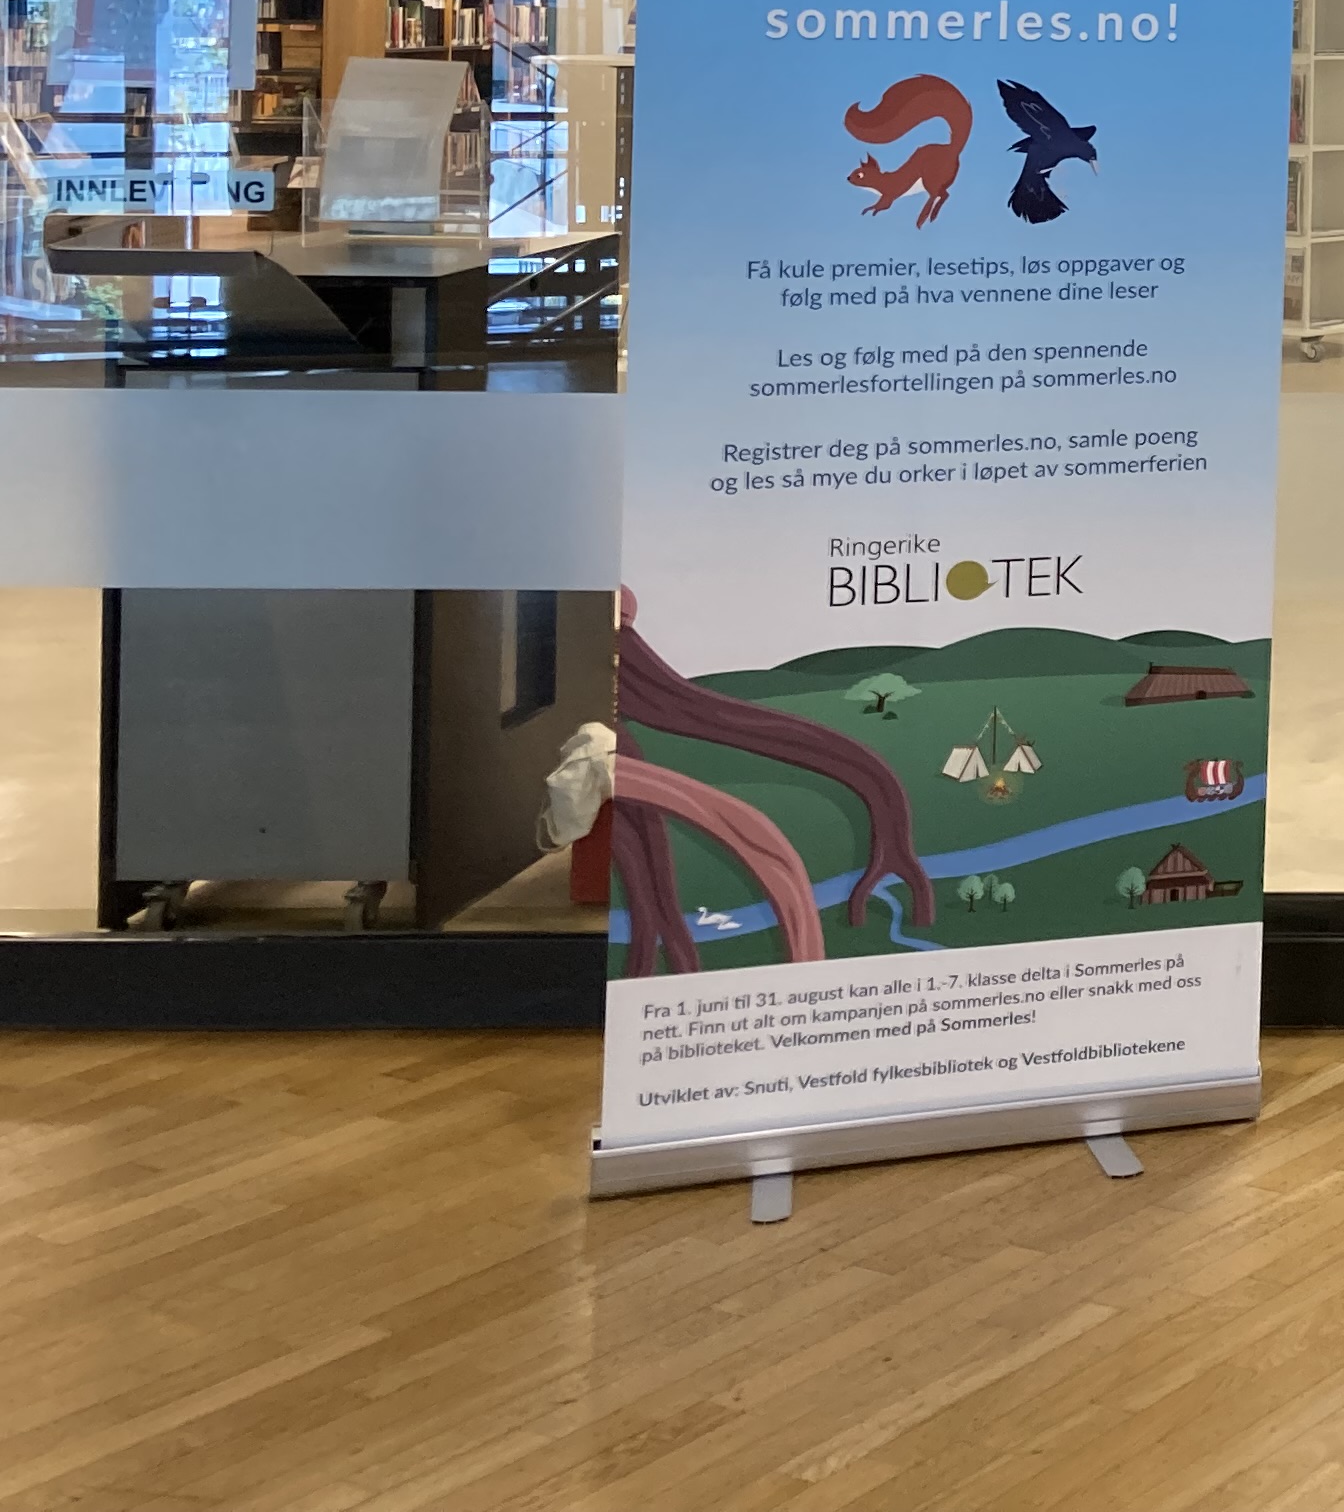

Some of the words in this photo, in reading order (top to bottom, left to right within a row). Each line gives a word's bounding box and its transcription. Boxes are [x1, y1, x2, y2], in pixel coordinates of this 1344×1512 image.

[766, 1, 1178, 41] sommerles.no!
[748, 260, 770, 279] Få
[780, 260, 824, 278] kule
[832, 258, 920, 281] premier,
[929, 257, 1014, 278] lesetips,
[1023, 256, 1050, 273] løs
[1058, 259, 1155, 276] oppgaver
[1161, 258, 1185, 274] og
[781, 288, 822, 310] følg
[830, 287, 876, 305] med
[885, 286, 908, 308] på
[918, 286, 953, 303] hva
[961, 288, 1051, 302] vennene
[1059, 283, 1102, 300] dine
[1111, 281, 1158, 299] leser
[779, 350, 812, 367] Les
[821, 353, 847, 369] og
[854, 346, 895, 368] følg
[903, 345, 947, 363] med
[956, 344, 980, 366] på
[988, 344, 1026, 361] den
[1034, 339, 1147, 363] spennende
[750, 373, 993, 396] sommerlesfortellingen
[1002, 370, 1025, 392] på
[1033, 367, 1176, 387] sommerles.no
[725, 442, 822, 465] Registrer
[829, 440, 868, 460] deg
[876, 437, 900, 460] på
[908, 434, 1061, 454] sommerles.no,
[1069, 429, 1128, 448] samle
[1135, 431, 1198, 449] poeng
[711, 477, 737, 495] og
[746, 472, 774, 489] les
[783, 469, 804, 488] så
[813, 472, 857, 489] mye
[865, 466, 891, 484] du
[900, 464, 956, 482] orker
[963, 463, 966, 480] i
[975, 462, 1028, 483] løpet
[1035, 464, 1058, 477] av
[1064, 454, 1206, 476] sommerferien
[831, 534, 940, 560] Ringerike
[644, 1005, 670, 1019] Fra
[678, 1002, 692, 1015] 1.
[697, 997, 728, 1016] juni
[735, 994, 750, 1009] til
[756, 992, 781, 1007] 31.
[788, 987, 843, 1005] august
[850, 984, 878, 997] kan
[884, 980, 911, 994] alle
[969, 973, 1016, 987] klasse
[1022, 967, 1060, 982] delta
[1075, 958, 1161, 977] Sommerles
[1167, 954, 1184, 971] på
[643, 1026, 682, 1040] nett.
[689, 1022, 725, 1036] Finn
[731, 1018, 748, 1031] ut
[754, 1014, 775, 1029] alt
[780, 1015, 806, 1026] om
[812, 1005, 902, 1023] kampanjen
[909, 999, 927, 1016] på
[933, 991, 1045, 1012] sommerles.no
[1050, 986, 1084, 1000] eller
[1089, 980, 1133, 996] snakk
[1139, 976, 1171, 991] med
[1177, 977, 1201, 988] oss
[642, 1047, 662, 1065] på
[669, 1035, 764, 1059] biblioteket.
[771, 1029, 870, 1048] Velkommen
[876, 1022, 911, 1038] med
[917, 1019, 935, 1037] på
[941, 1010, 1035, 1031] Sommerles!
[640, 1088, 709, 1106] Utviklet
[715, 1087, 739, 1099] av:
[744, 1077, 793, 1095] Snuti,
[798, 1069, 867, 1089] Vestfold
[873, 1056, 993, 1083] fylkesbibliotek
[998, 1058, 1017, 1070] og
[1022, 1040, 1185, 1065] Vestfoldbibliotekene
